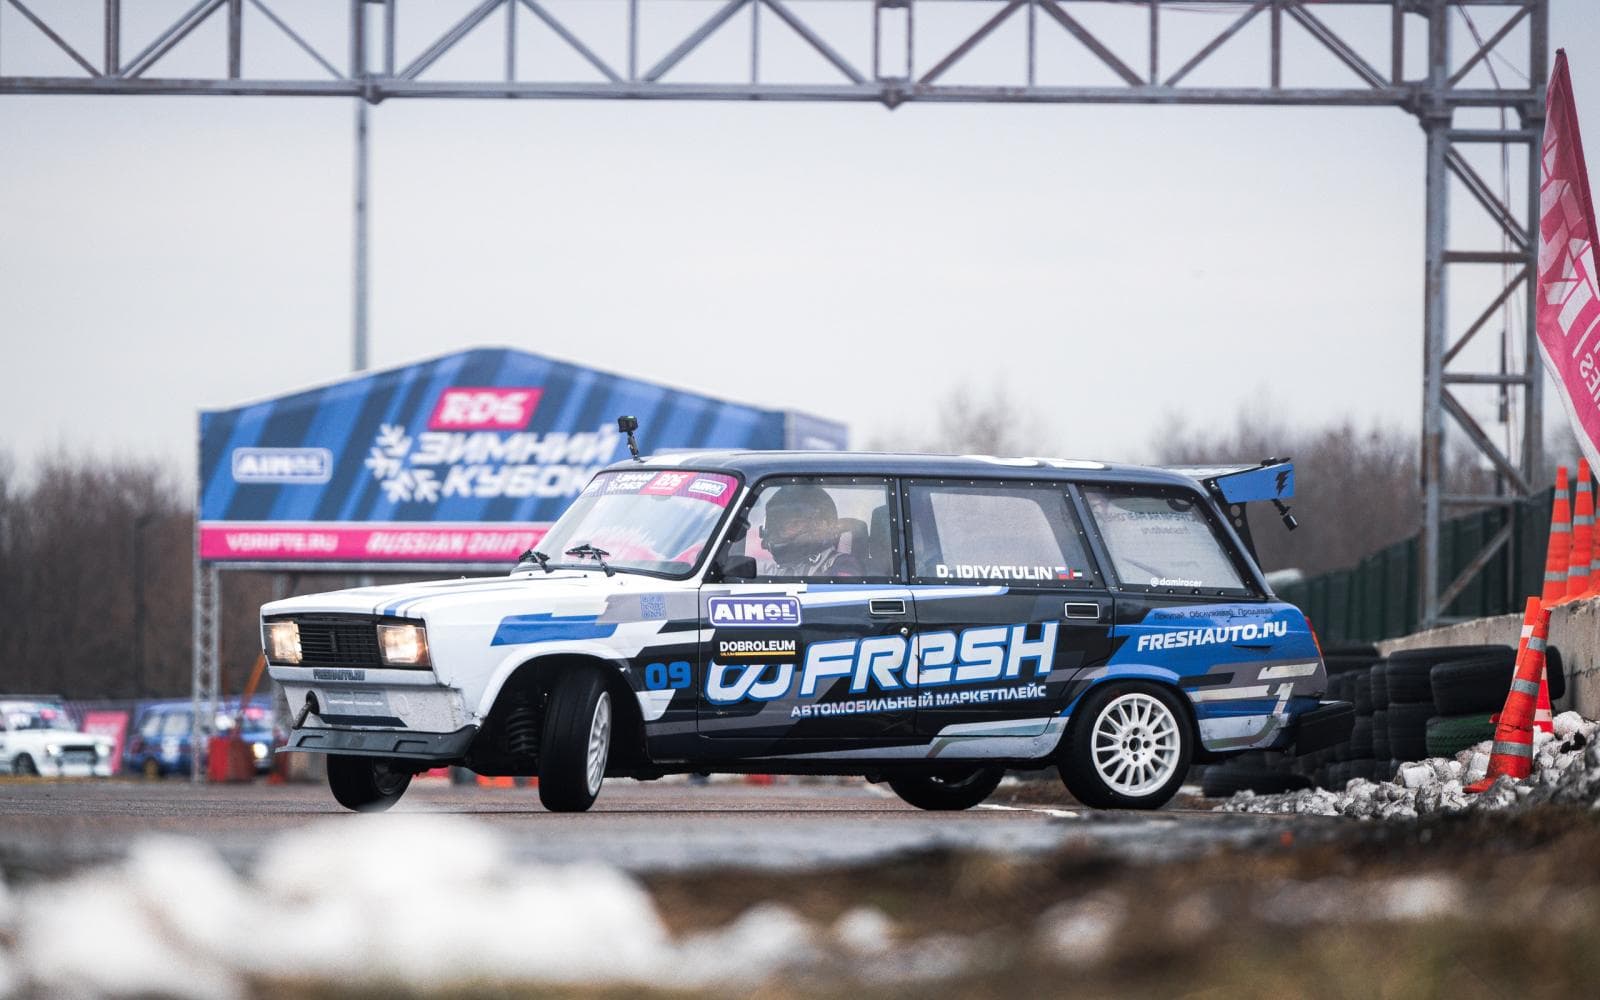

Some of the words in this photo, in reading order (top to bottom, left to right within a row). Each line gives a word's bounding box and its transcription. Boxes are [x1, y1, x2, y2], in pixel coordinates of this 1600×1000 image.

[956, 565, 1053, 580] IDIYATULIN
[713, 603, 796, 621] AIMOL
[720, 640, 796, 651] DOBROLEUM
[1137, 620, 1287, 652] FRESHAUTO.RU
[645, 661, 692, 690] 09
[790, 692, 934, 718] АВТОМОБИЛЬНЫЙ
[936, 683, 1047, 706] МАРКЕТПЛЕЙС
